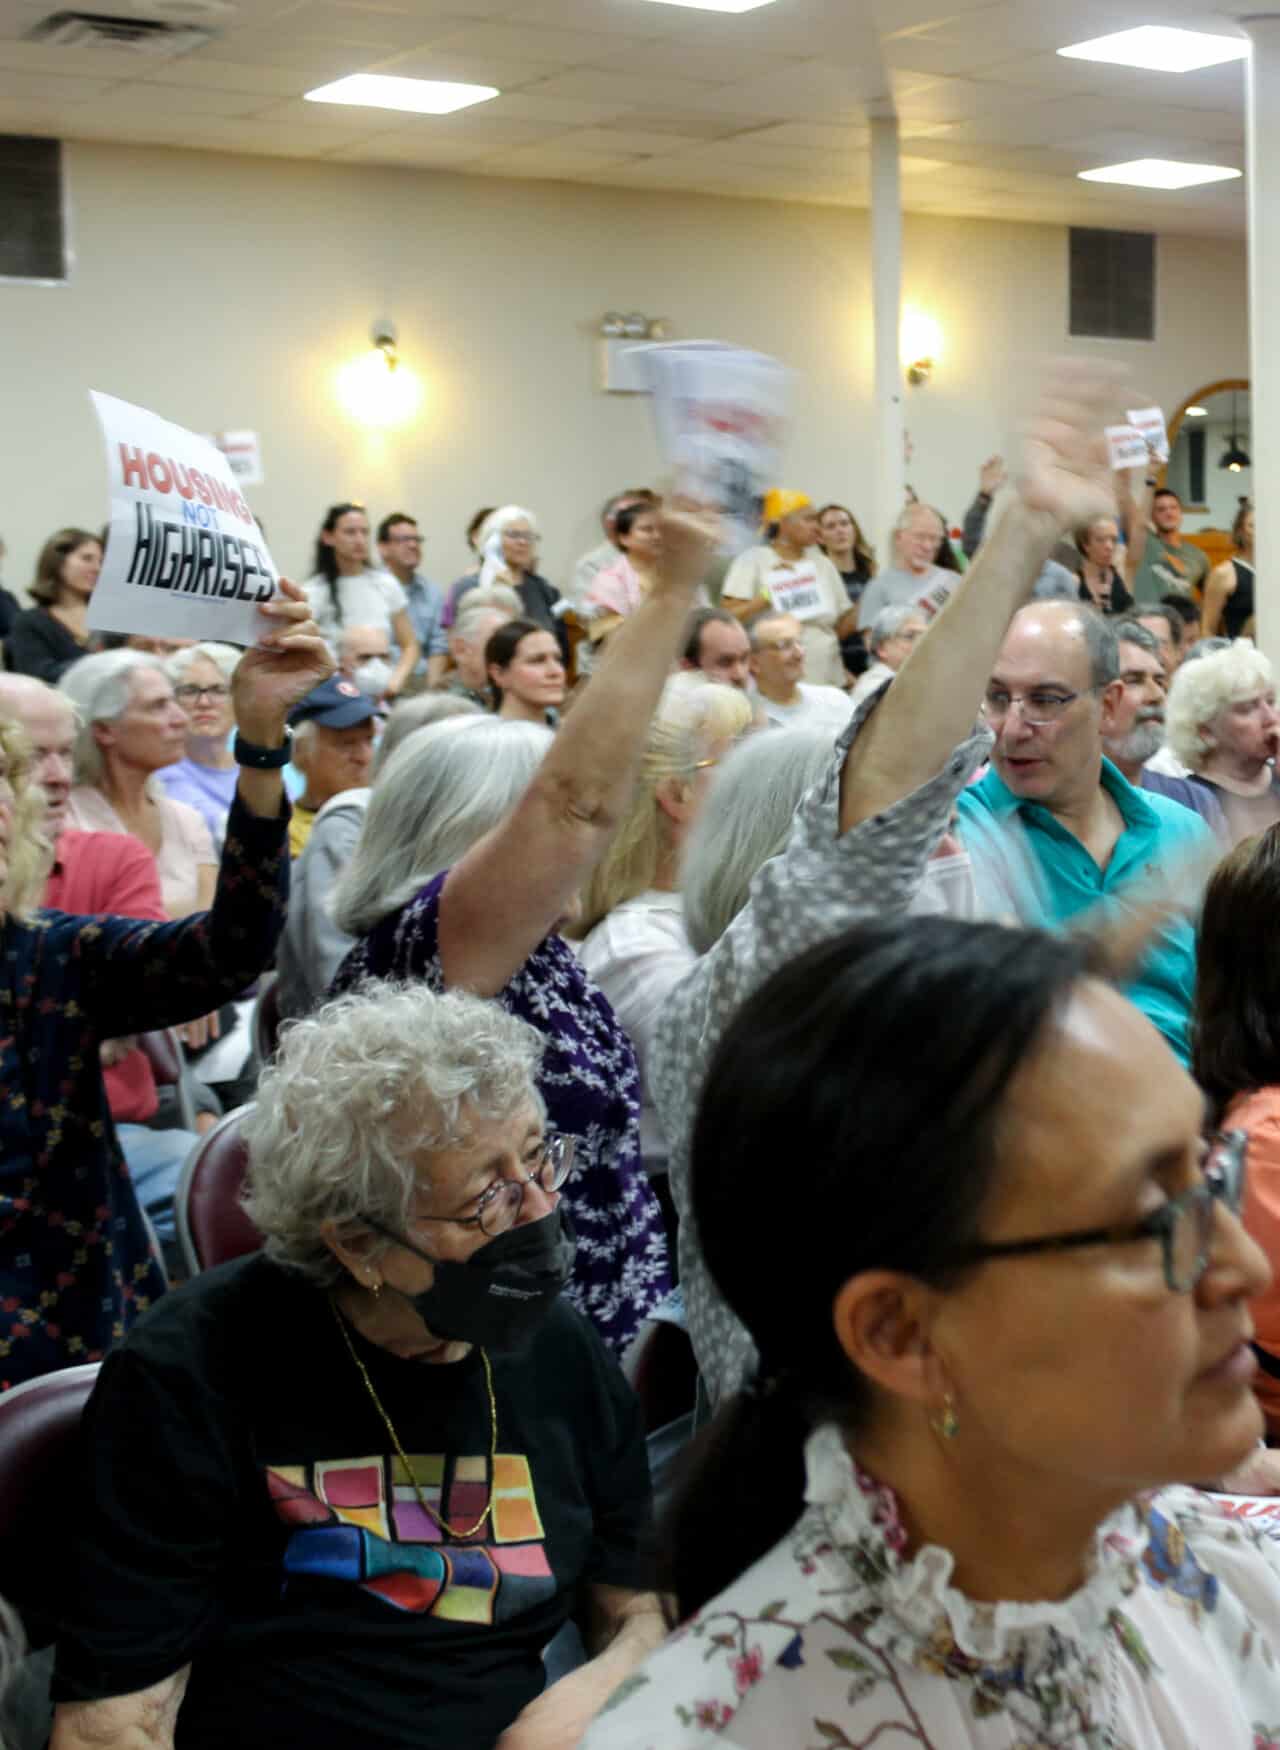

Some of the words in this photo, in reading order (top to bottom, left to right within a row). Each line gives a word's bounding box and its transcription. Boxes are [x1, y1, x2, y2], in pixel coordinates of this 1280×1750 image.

[118, 442, 254, 526] HOUSING
[182, 501, 218, 528] NOT
[127, 501, 275, 602] HIGHRISES
